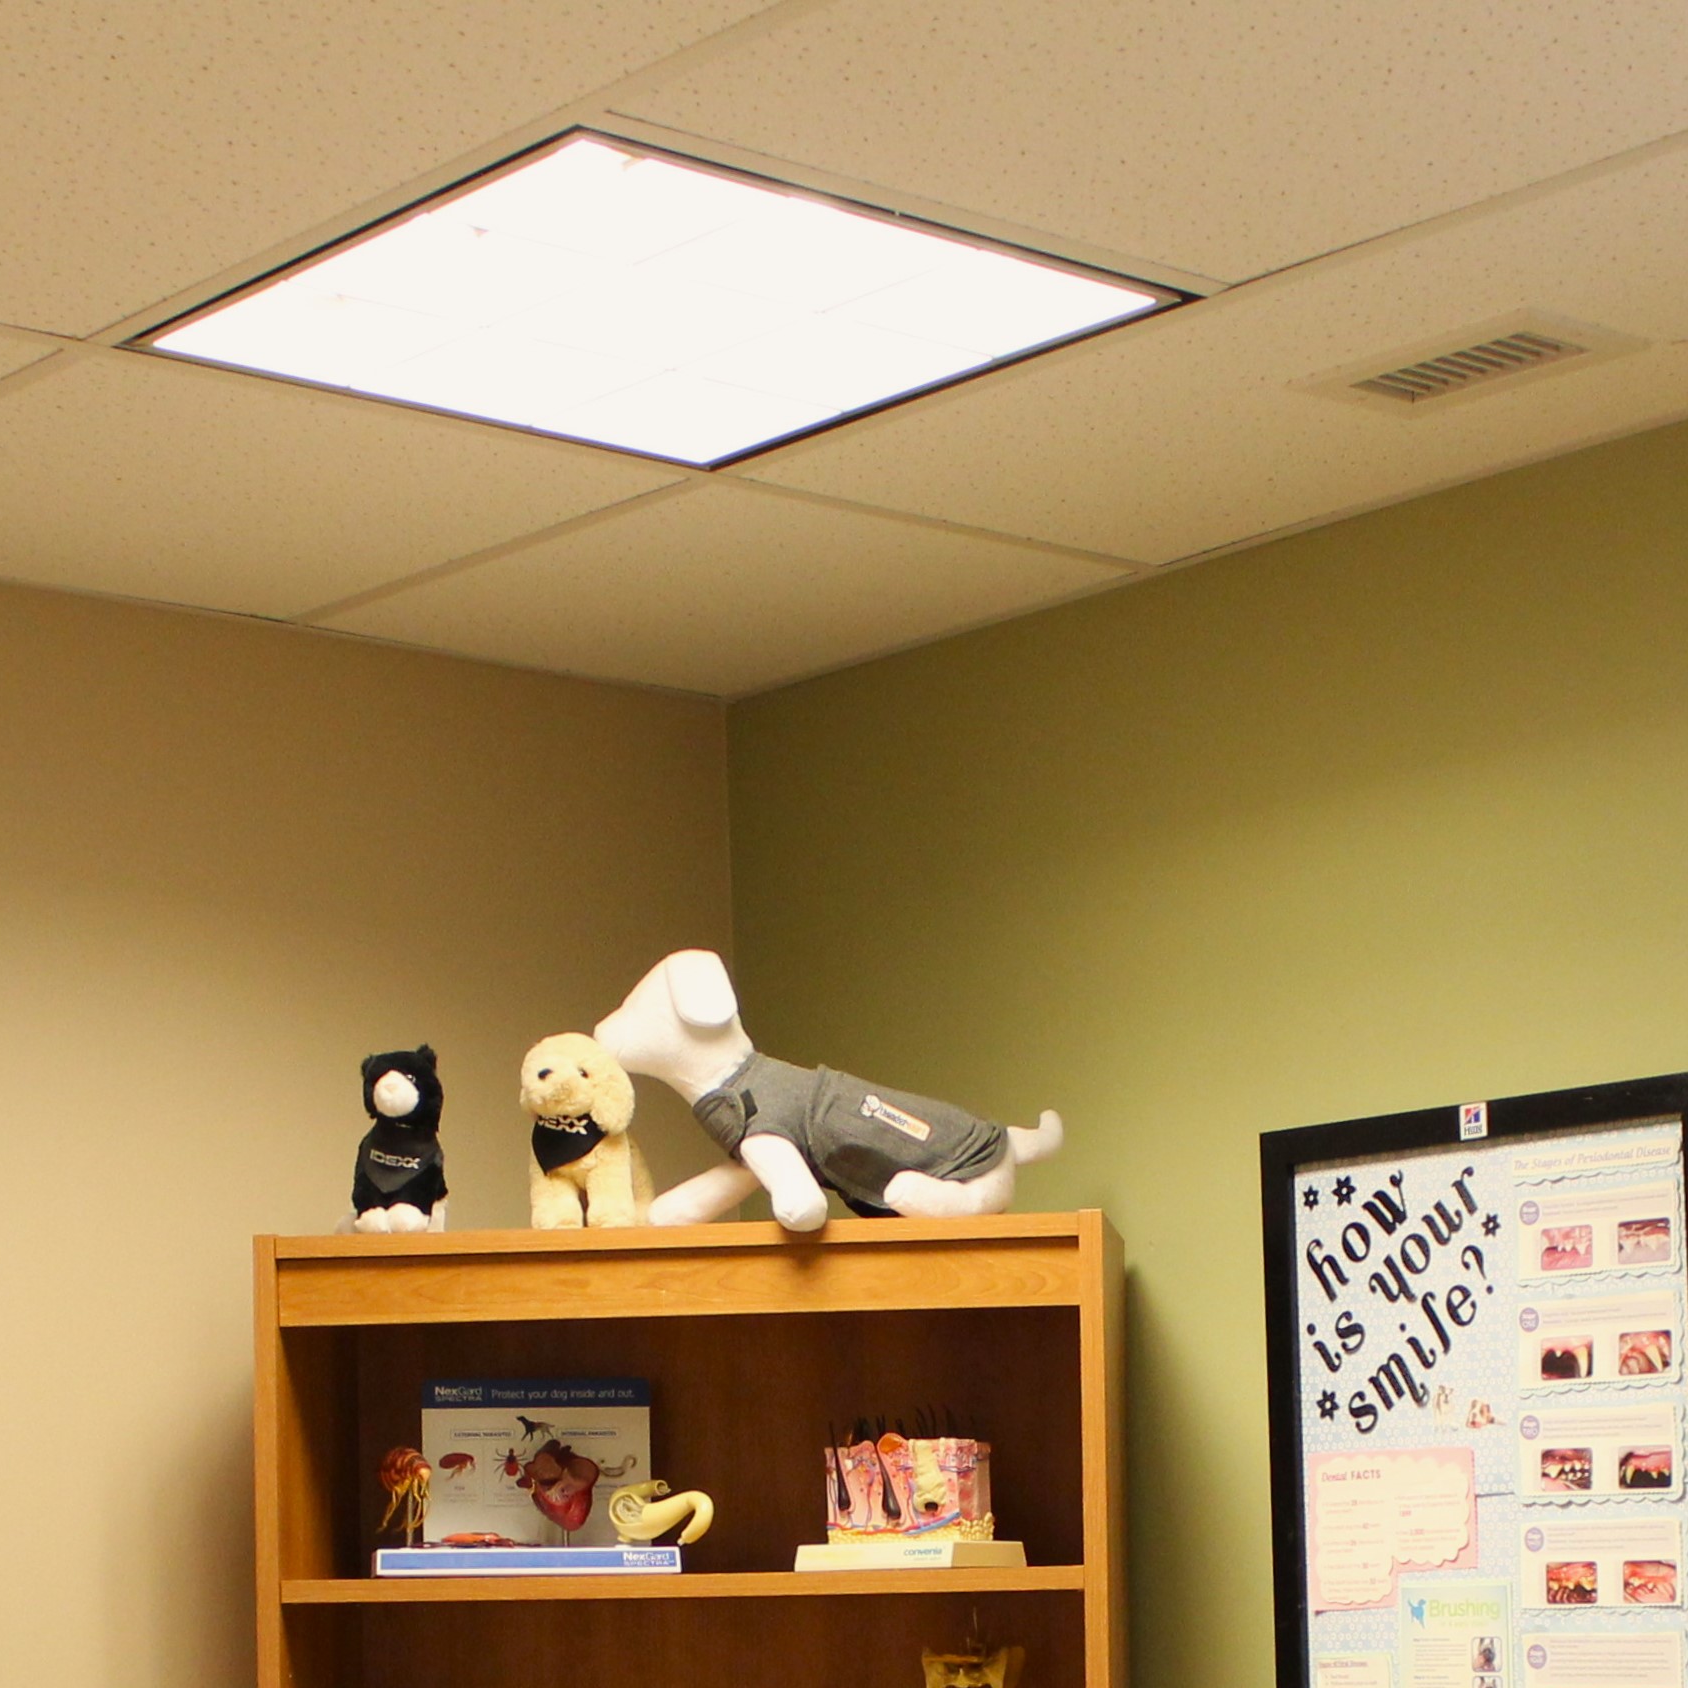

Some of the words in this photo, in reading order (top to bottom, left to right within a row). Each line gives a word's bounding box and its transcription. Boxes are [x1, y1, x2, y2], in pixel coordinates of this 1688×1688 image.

[370, 1149, 421, 1169] IDEXX
[1514, 1159, 1530, 1170] The
[1531, 1157, 1563, 1170] Stages
[1565, 1154, 1576, 1166] of
[1577, 1148, 1634, 1164] Periodontal
[1636, 1146, 1671, 1158] Disease
[1307, 1169, 1408, 1303] how
[1369, 1166, 1479, 1303] your
[1307, 1311, 1366, 1373] is
[434, 1386, 483, 1396] NexGard
[492, 1388, 525, 1399] Protect
[528, 1389, 548, 1401] your
[550, 1388, 568, 1400] dog
[570, 1388, 596, 1399] inside
[598, 1388, 615, 1398] and
[1351, 1470, 1382, 1481] FACTS
[623, 1551, 670, 1562] NexGard
[1429, 1598, 1501, 1620] Brushing
